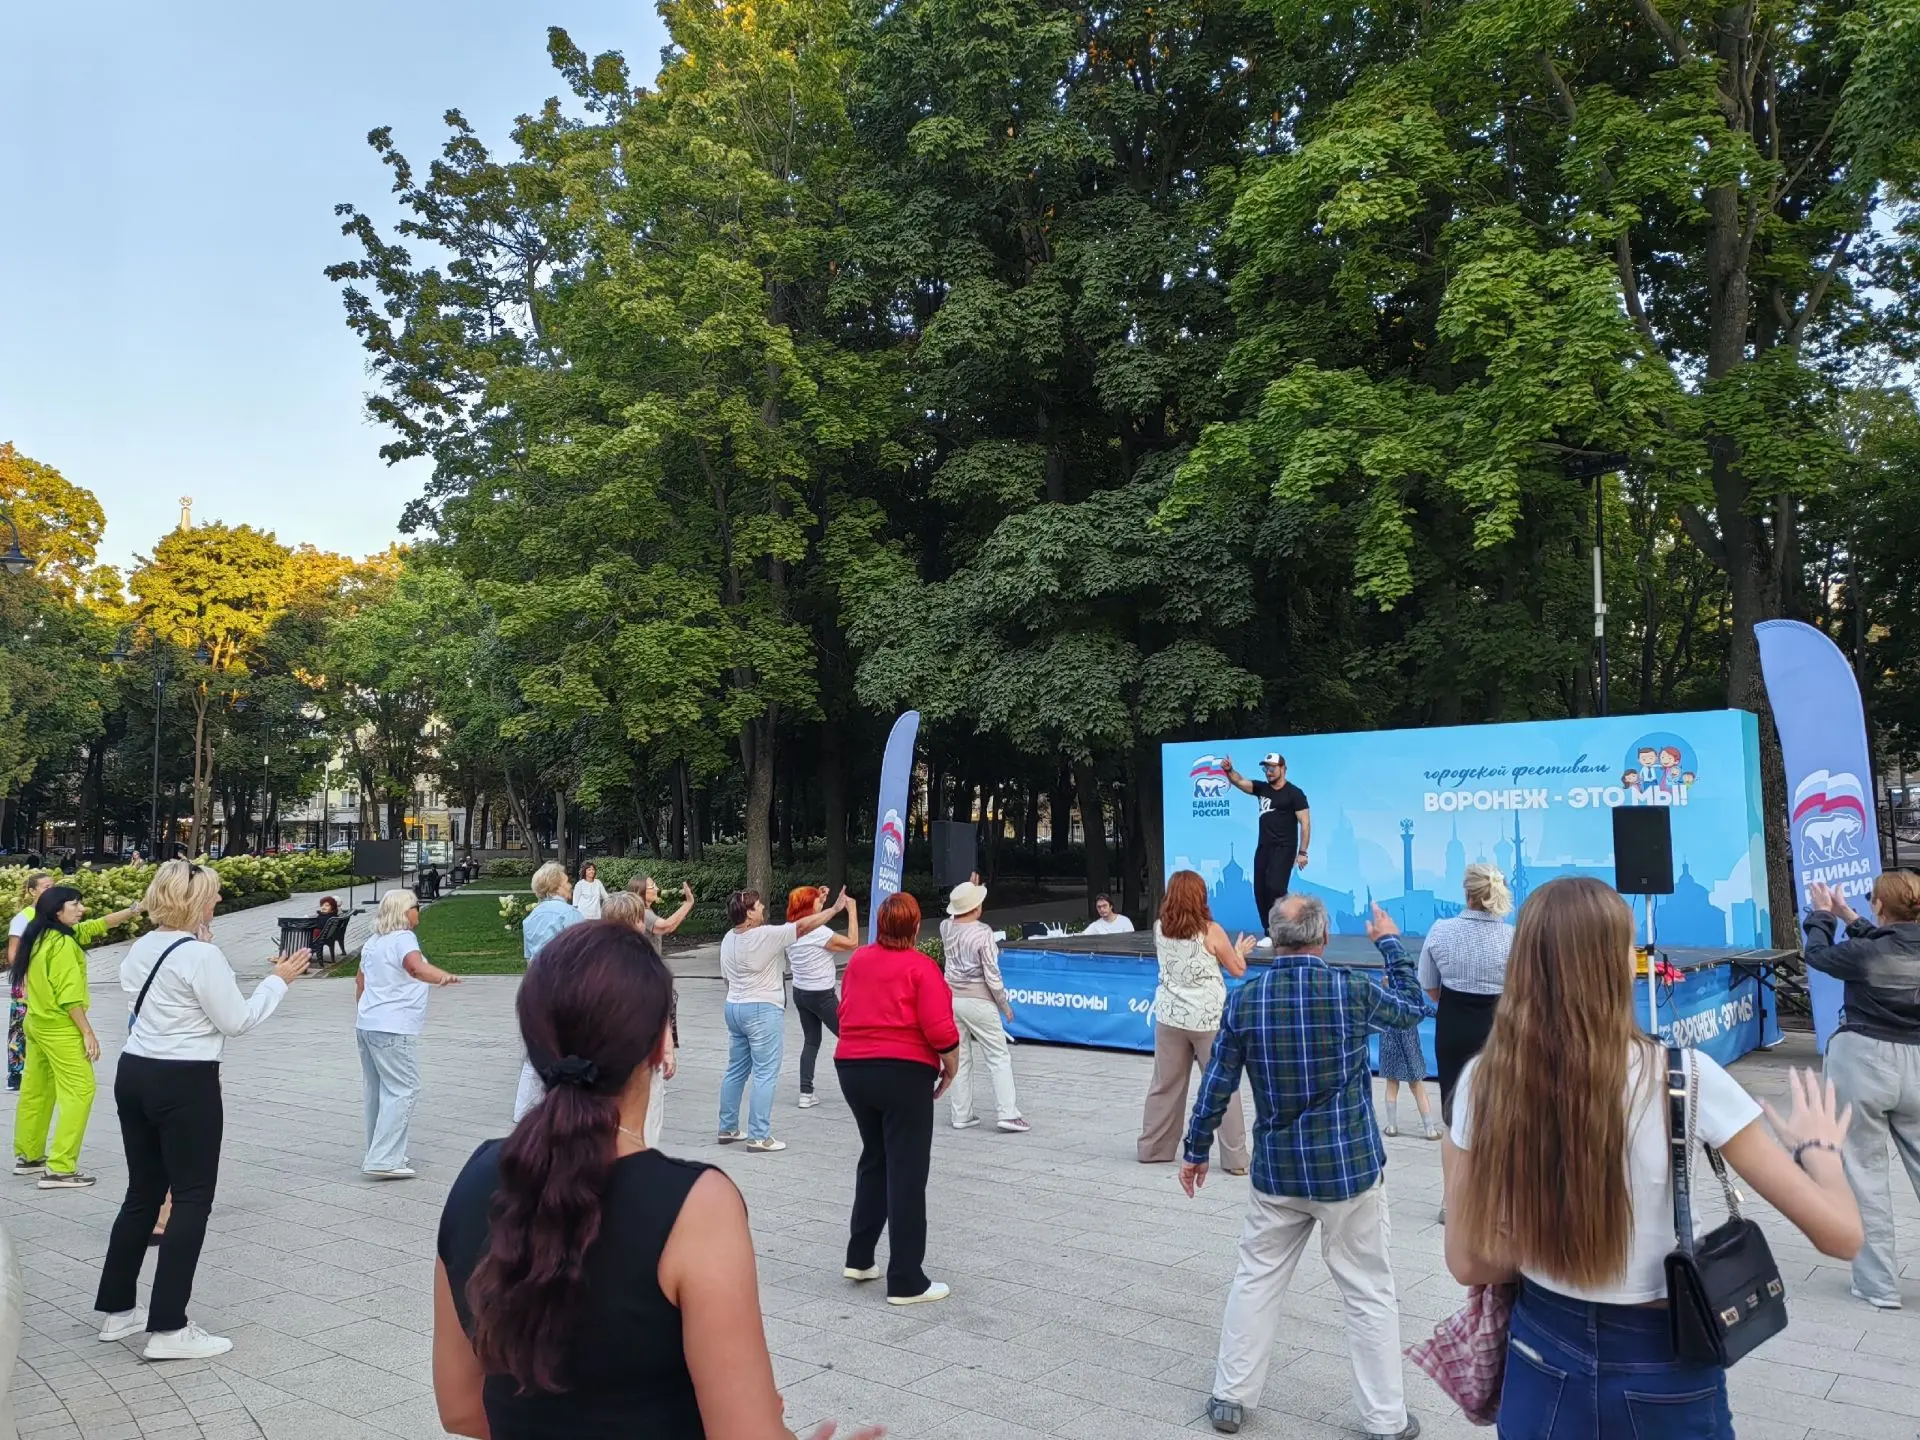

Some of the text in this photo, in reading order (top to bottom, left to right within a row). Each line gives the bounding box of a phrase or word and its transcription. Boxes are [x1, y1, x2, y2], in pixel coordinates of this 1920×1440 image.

[1424, 754, 1611, 788] городской фестиваль
[1192, 799, 1230, 809] ЕДИНАЯ
[1423, 787, 1549, 812] ВОРОНЕЖ
[1567, 785, 1625, 809] ЭТО
[1631, 784, 1689, 807] МЫ!
[1192, 808, 1230, 818] РОССИЯ
[1801, 857, 1871, 886] ЕДИНАЯ
[1003, 987, 1108, 1011] РОНЕЖЭТОМЫ
